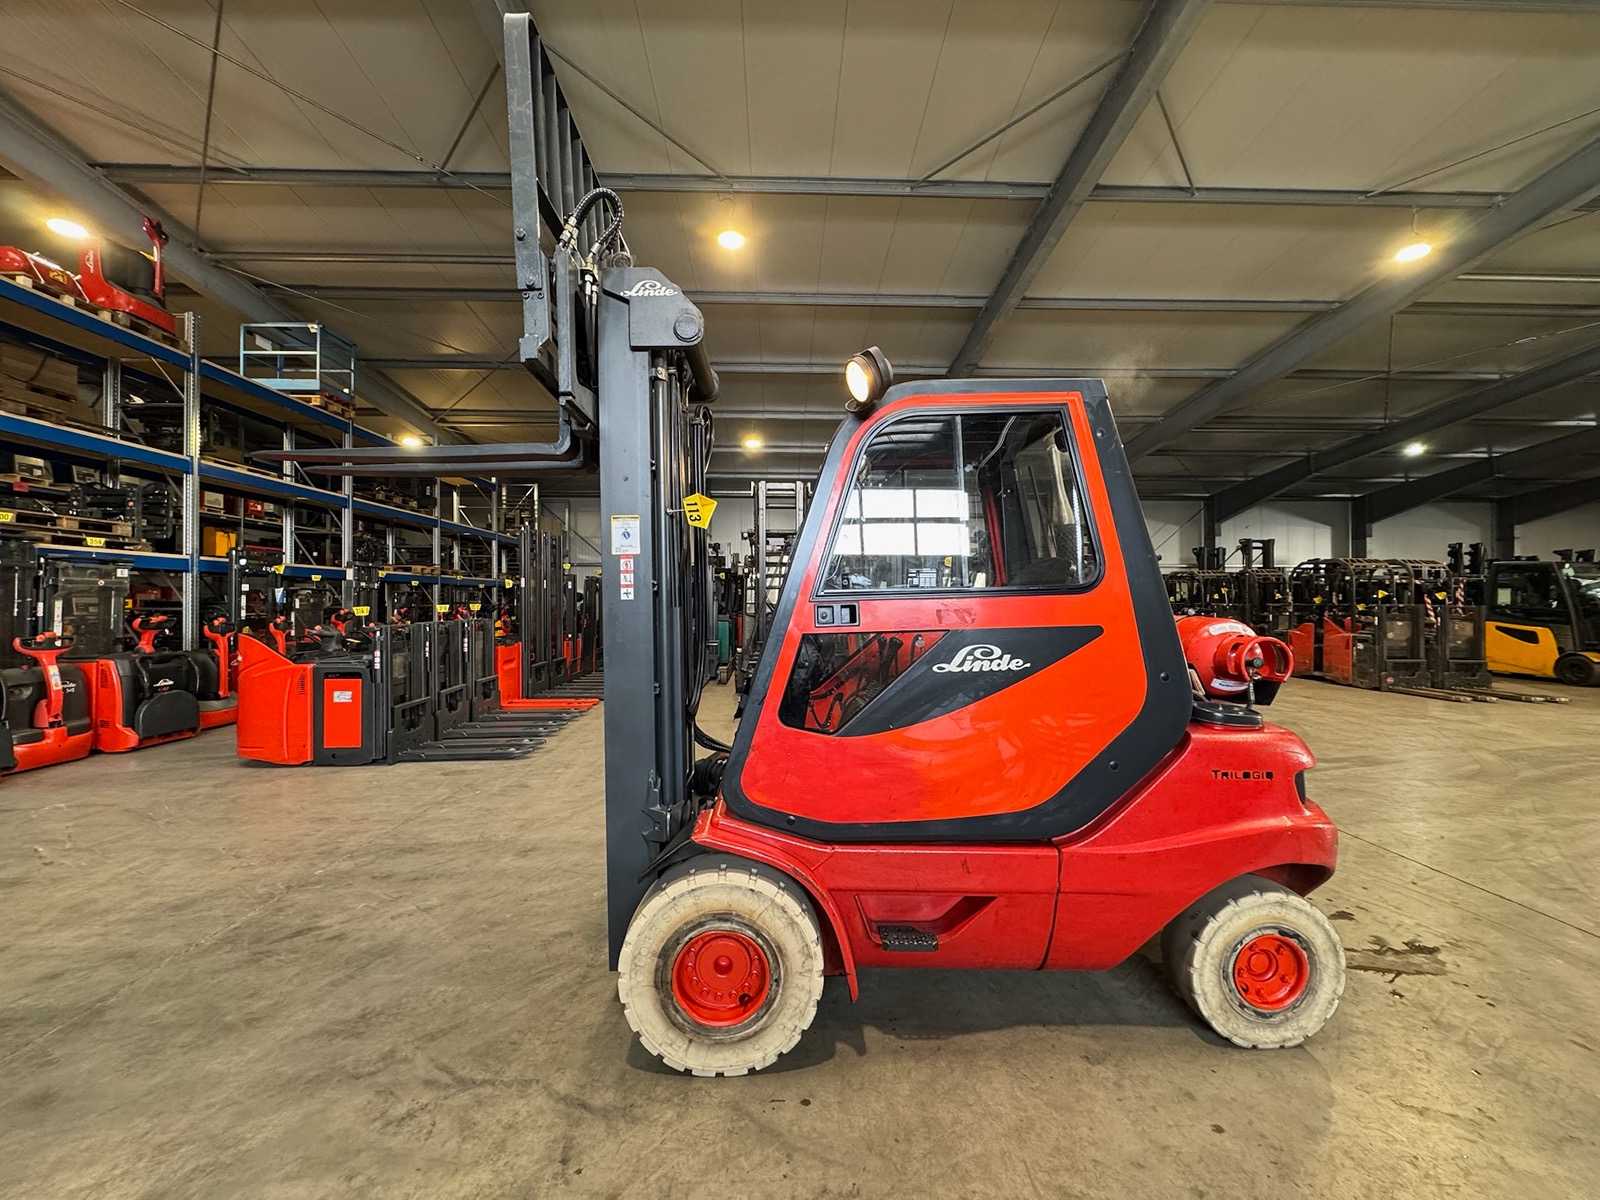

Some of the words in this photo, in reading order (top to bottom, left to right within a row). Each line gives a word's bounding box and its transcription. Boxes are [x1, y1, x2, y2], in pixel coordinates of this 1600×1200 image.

[620, 280, 678, 297] Linde
[686, 502, 702, 522] 113
[932, 644, 1031, 673] Linde
